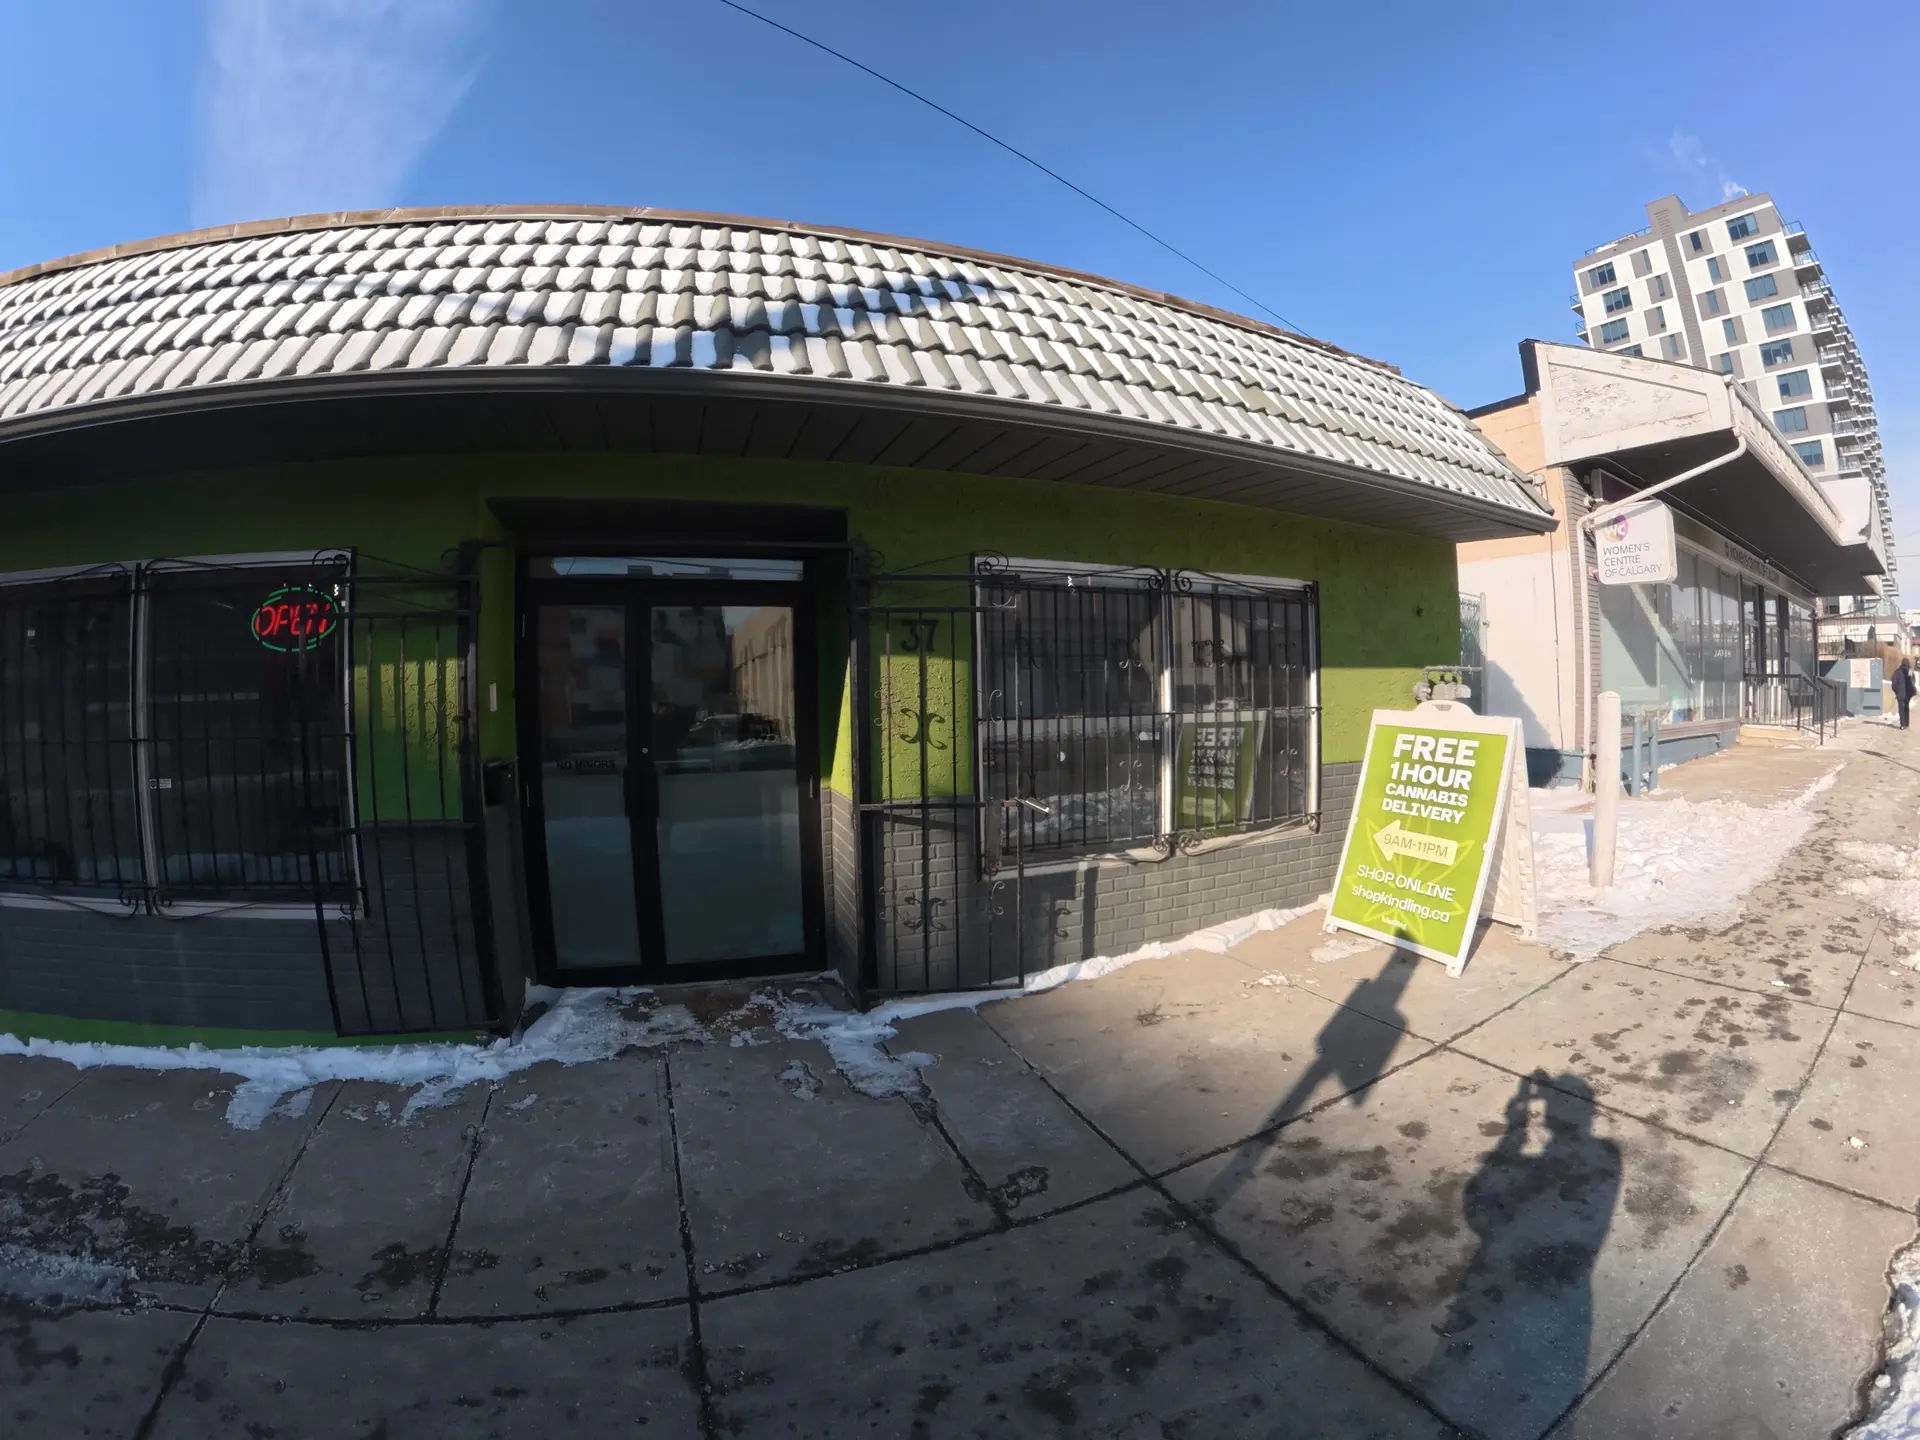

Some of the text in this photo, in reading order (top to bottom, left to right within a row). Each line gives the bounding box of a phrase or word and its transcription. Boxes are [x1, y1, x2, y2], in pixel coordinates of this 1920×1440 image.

[1603, 542, 1650, 556] WOMEN'S
[1604, 555, 1641, 567] CENTRE
[1604, 564, 1662, 578] OF CALGARY
[1393, 733, 1480, 767] FREE
[1390, 761, 1473, 790] 1 HOUR
[1385, 783, 1469, 807] CANNABIS
[1381, 797, 1465, 825] DELIVERY
[1383, 832, 1449, 858] 9AM-11PM
[1356, 864, 1456, 902] SHOP ONLINE
[1351, 884, 1450, 923] shopkindling.ca
